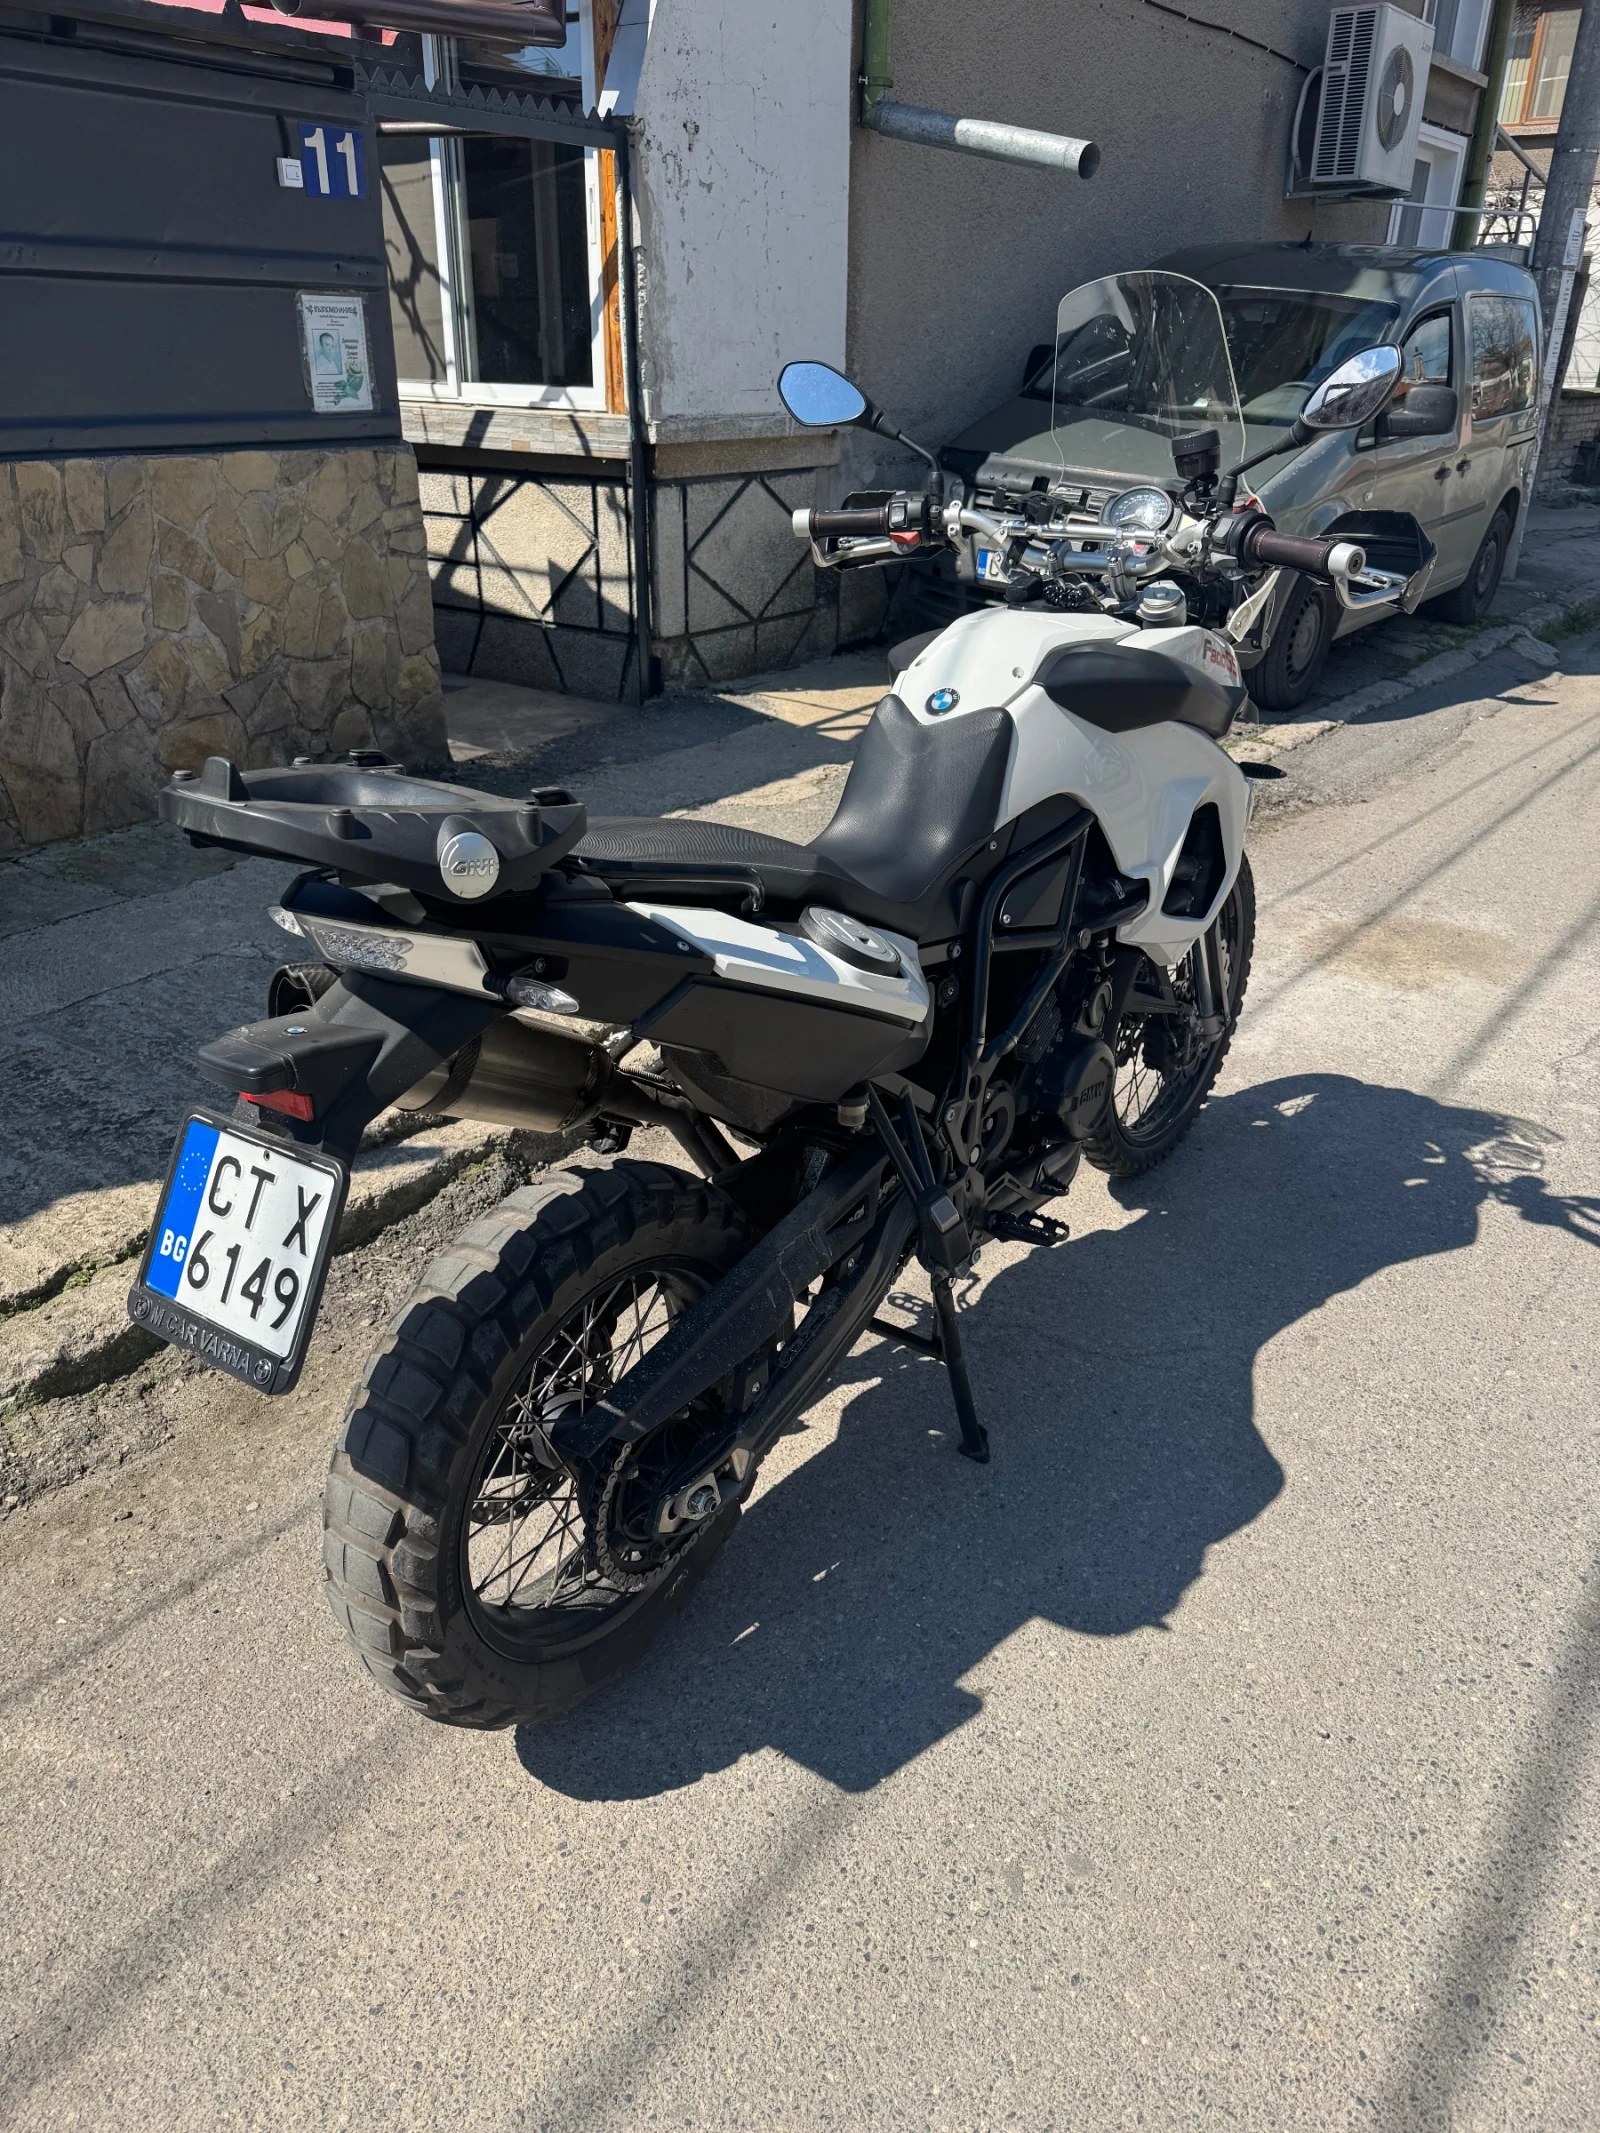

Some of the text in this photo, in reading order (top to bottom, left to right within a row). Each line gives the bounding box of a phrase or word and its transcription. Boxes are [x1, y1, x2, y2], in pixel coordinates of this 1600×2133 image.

[304, 128, 359, 196] 11
[450, 858, 494, 876] GIVI
[1080, 1081, 1105, 1105] BMW
[208, 1155, 322, 1256] CT X
[160, 1229, 187, 1263] BG
[187, 1230, 300, 1330] 6149
[200, 1329, 251, 1374] VARNA
